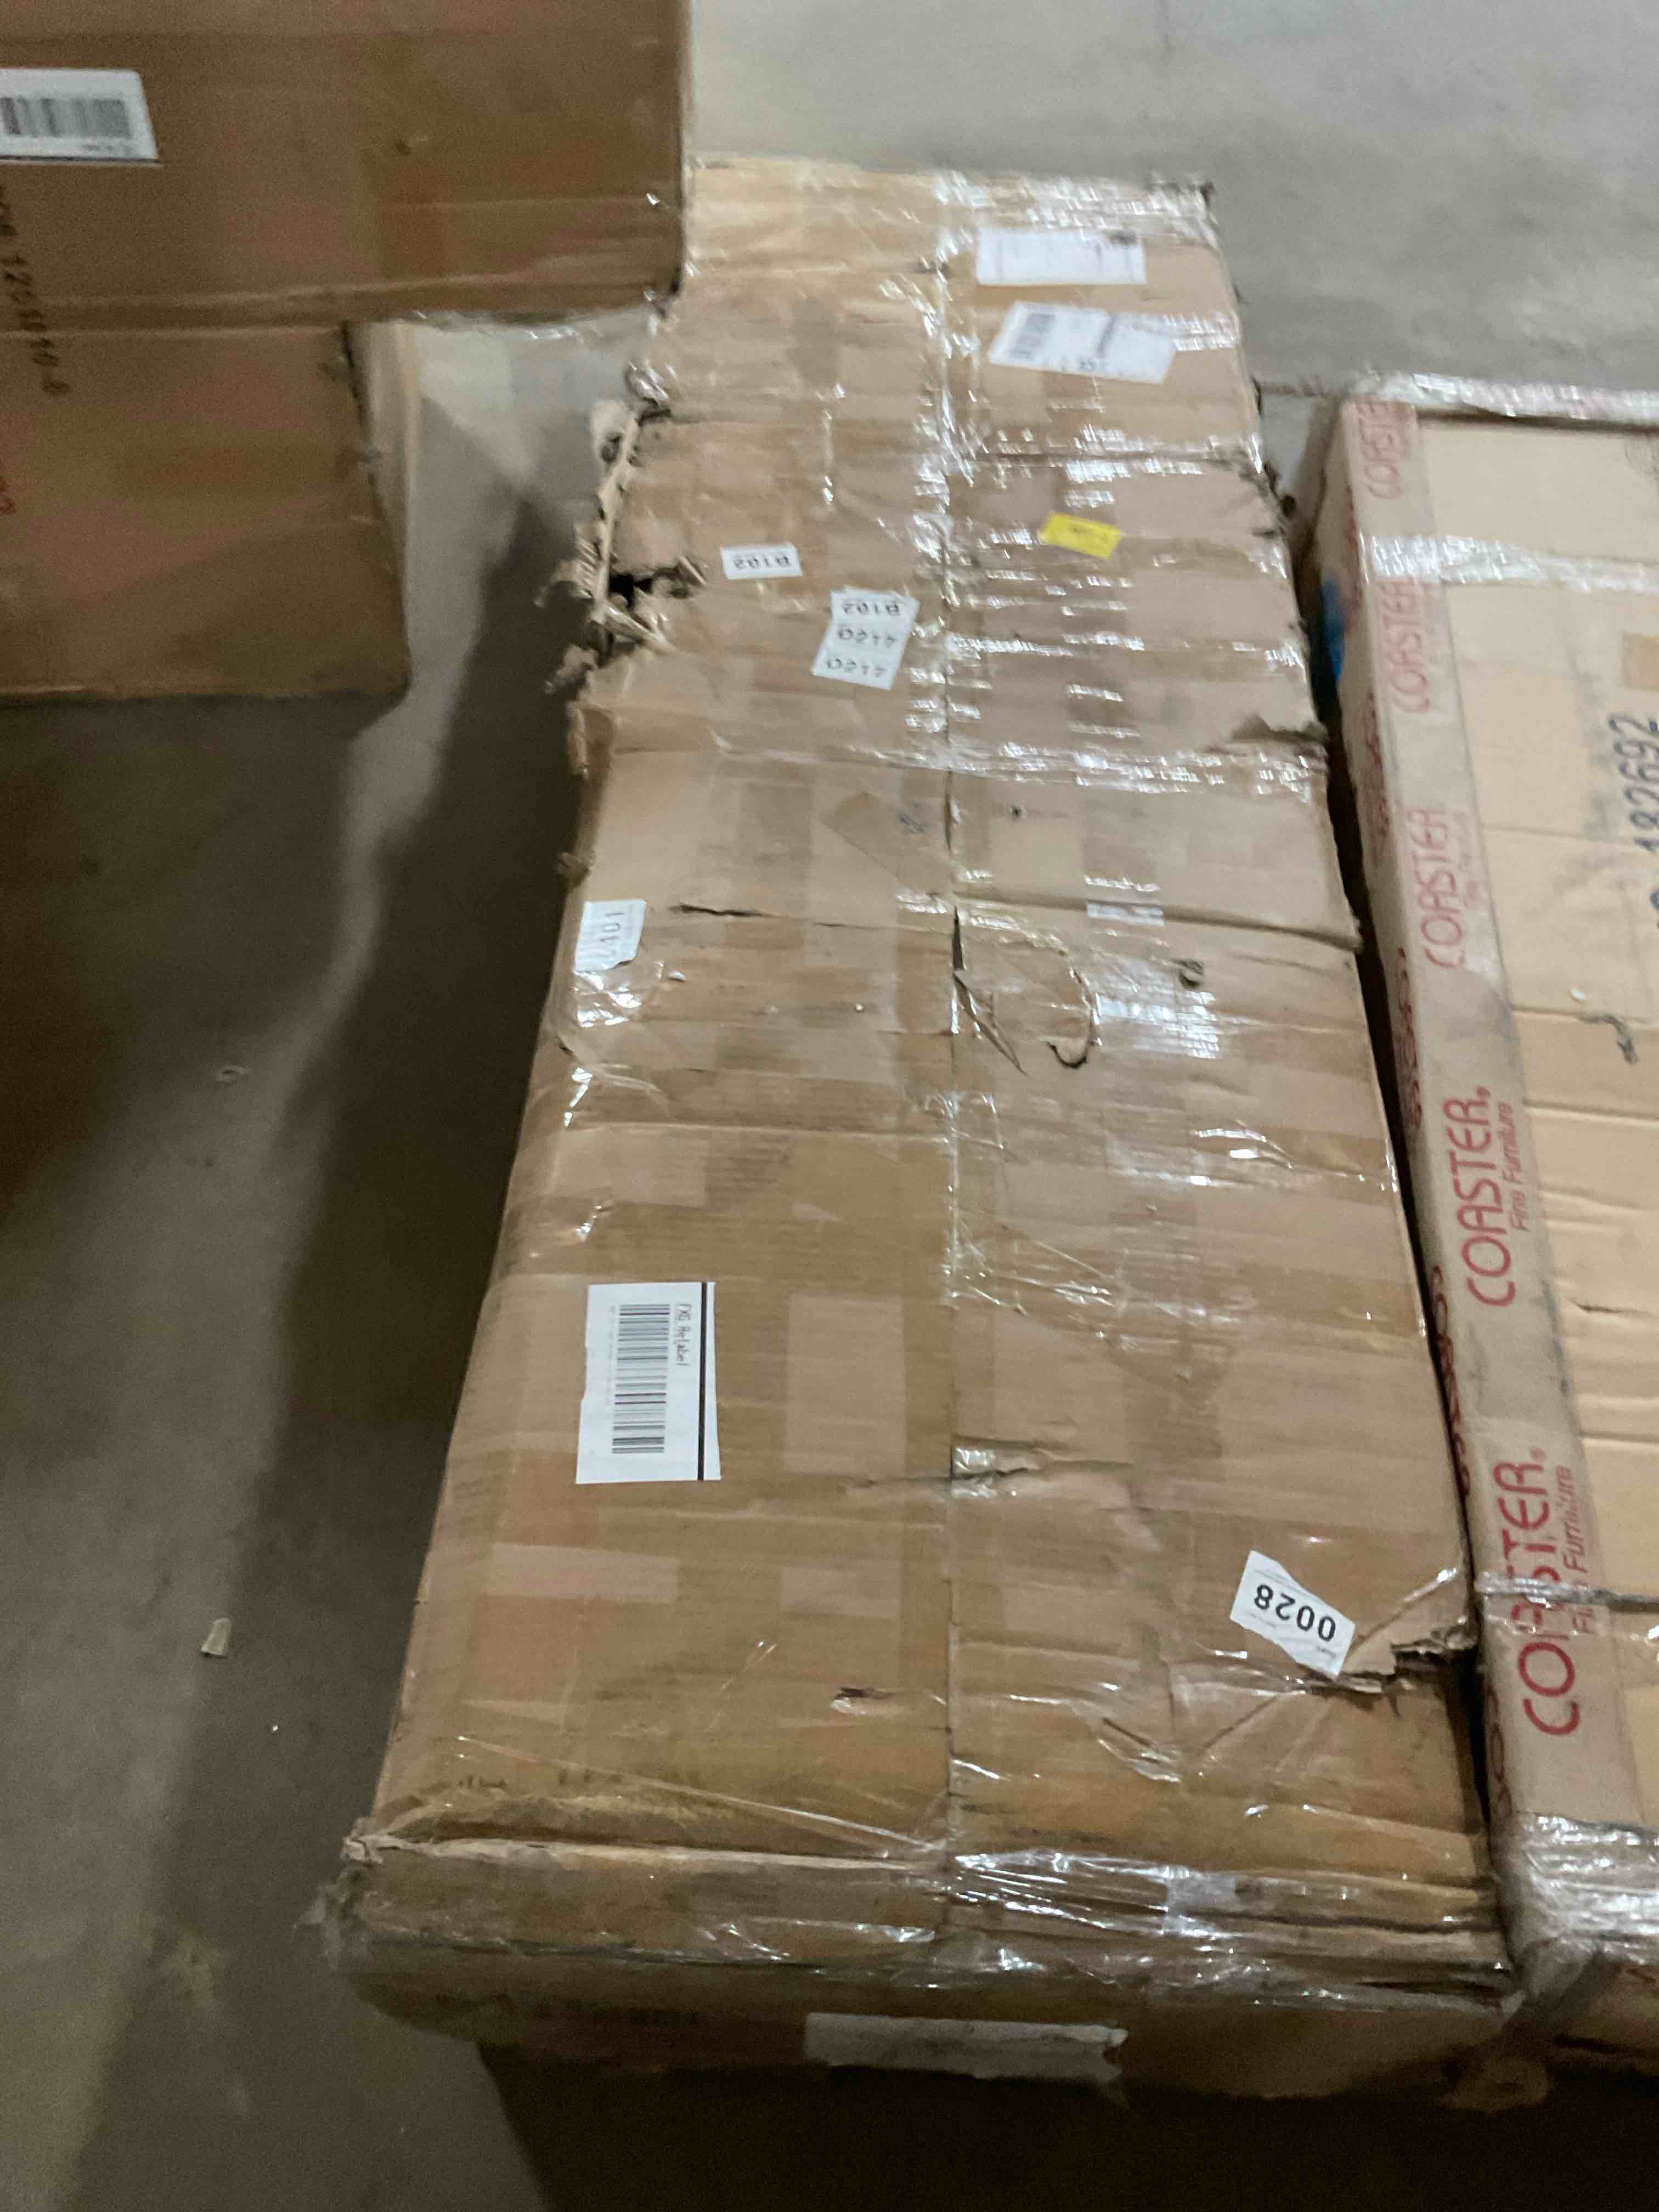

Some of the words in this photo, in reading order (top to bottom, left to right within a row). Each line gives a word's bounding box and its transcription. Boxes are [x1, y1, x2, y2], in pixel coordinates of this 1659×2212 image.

[1406, 808, 1465, 969] COASTER
[1442, 1097, 1515, 1307] COASTER
[1254, 1584, 1336, 1642] 0028
